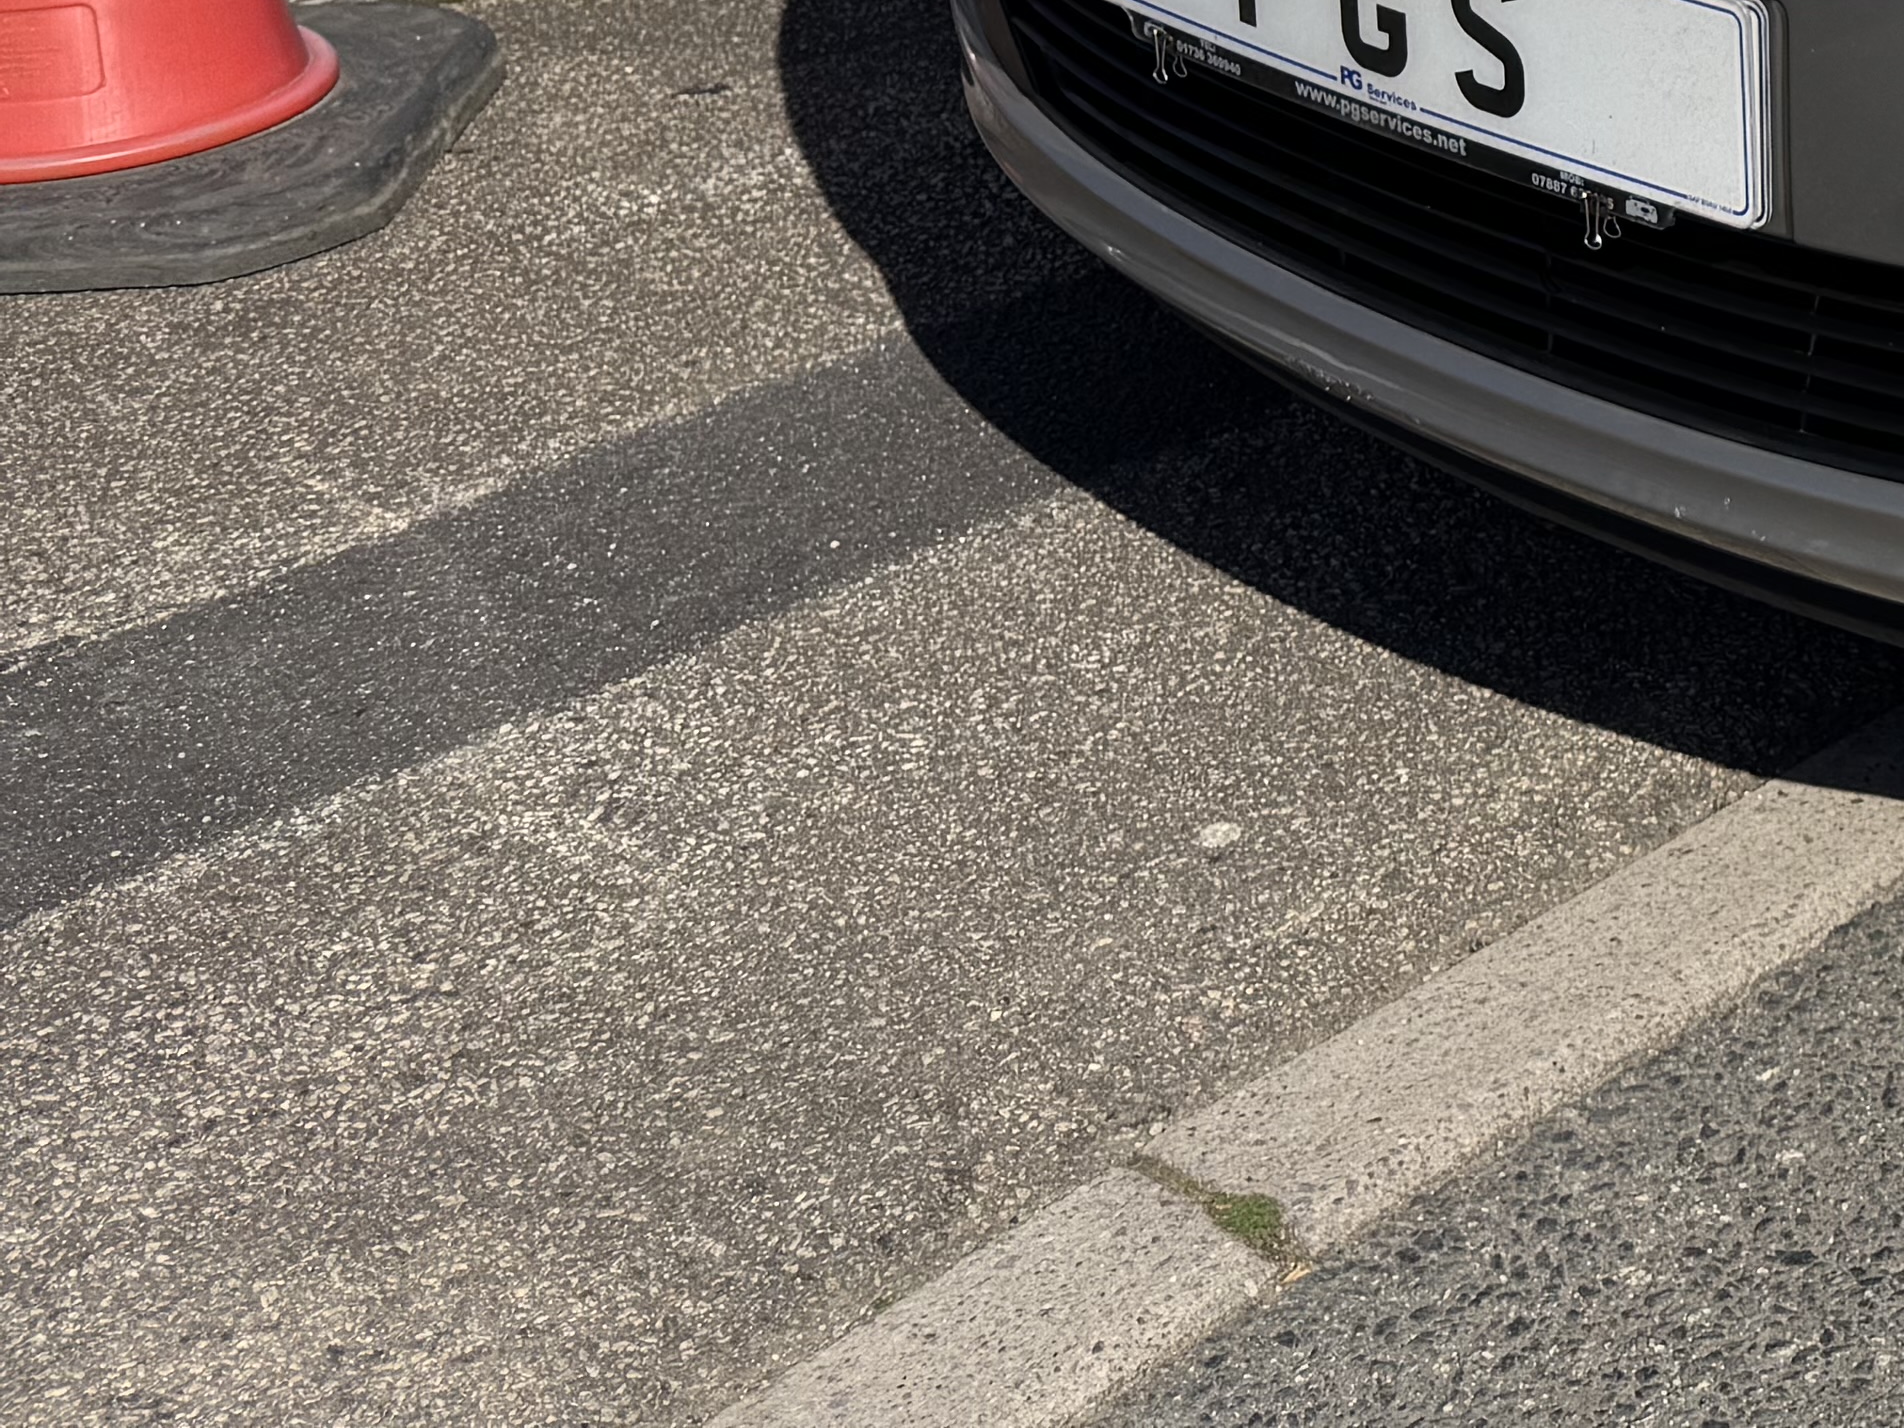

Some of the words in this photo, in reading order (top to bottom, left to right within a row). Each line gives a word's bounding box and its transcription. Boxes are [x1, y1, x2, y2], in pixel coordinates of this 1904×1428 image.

[1339, 65, 1363, 91] PG
[1366, 82, 1418, 111] Services
[1294, 80, 1468, 157] www.pgservices.net
[1531, 172, 1568, 194] 07887
